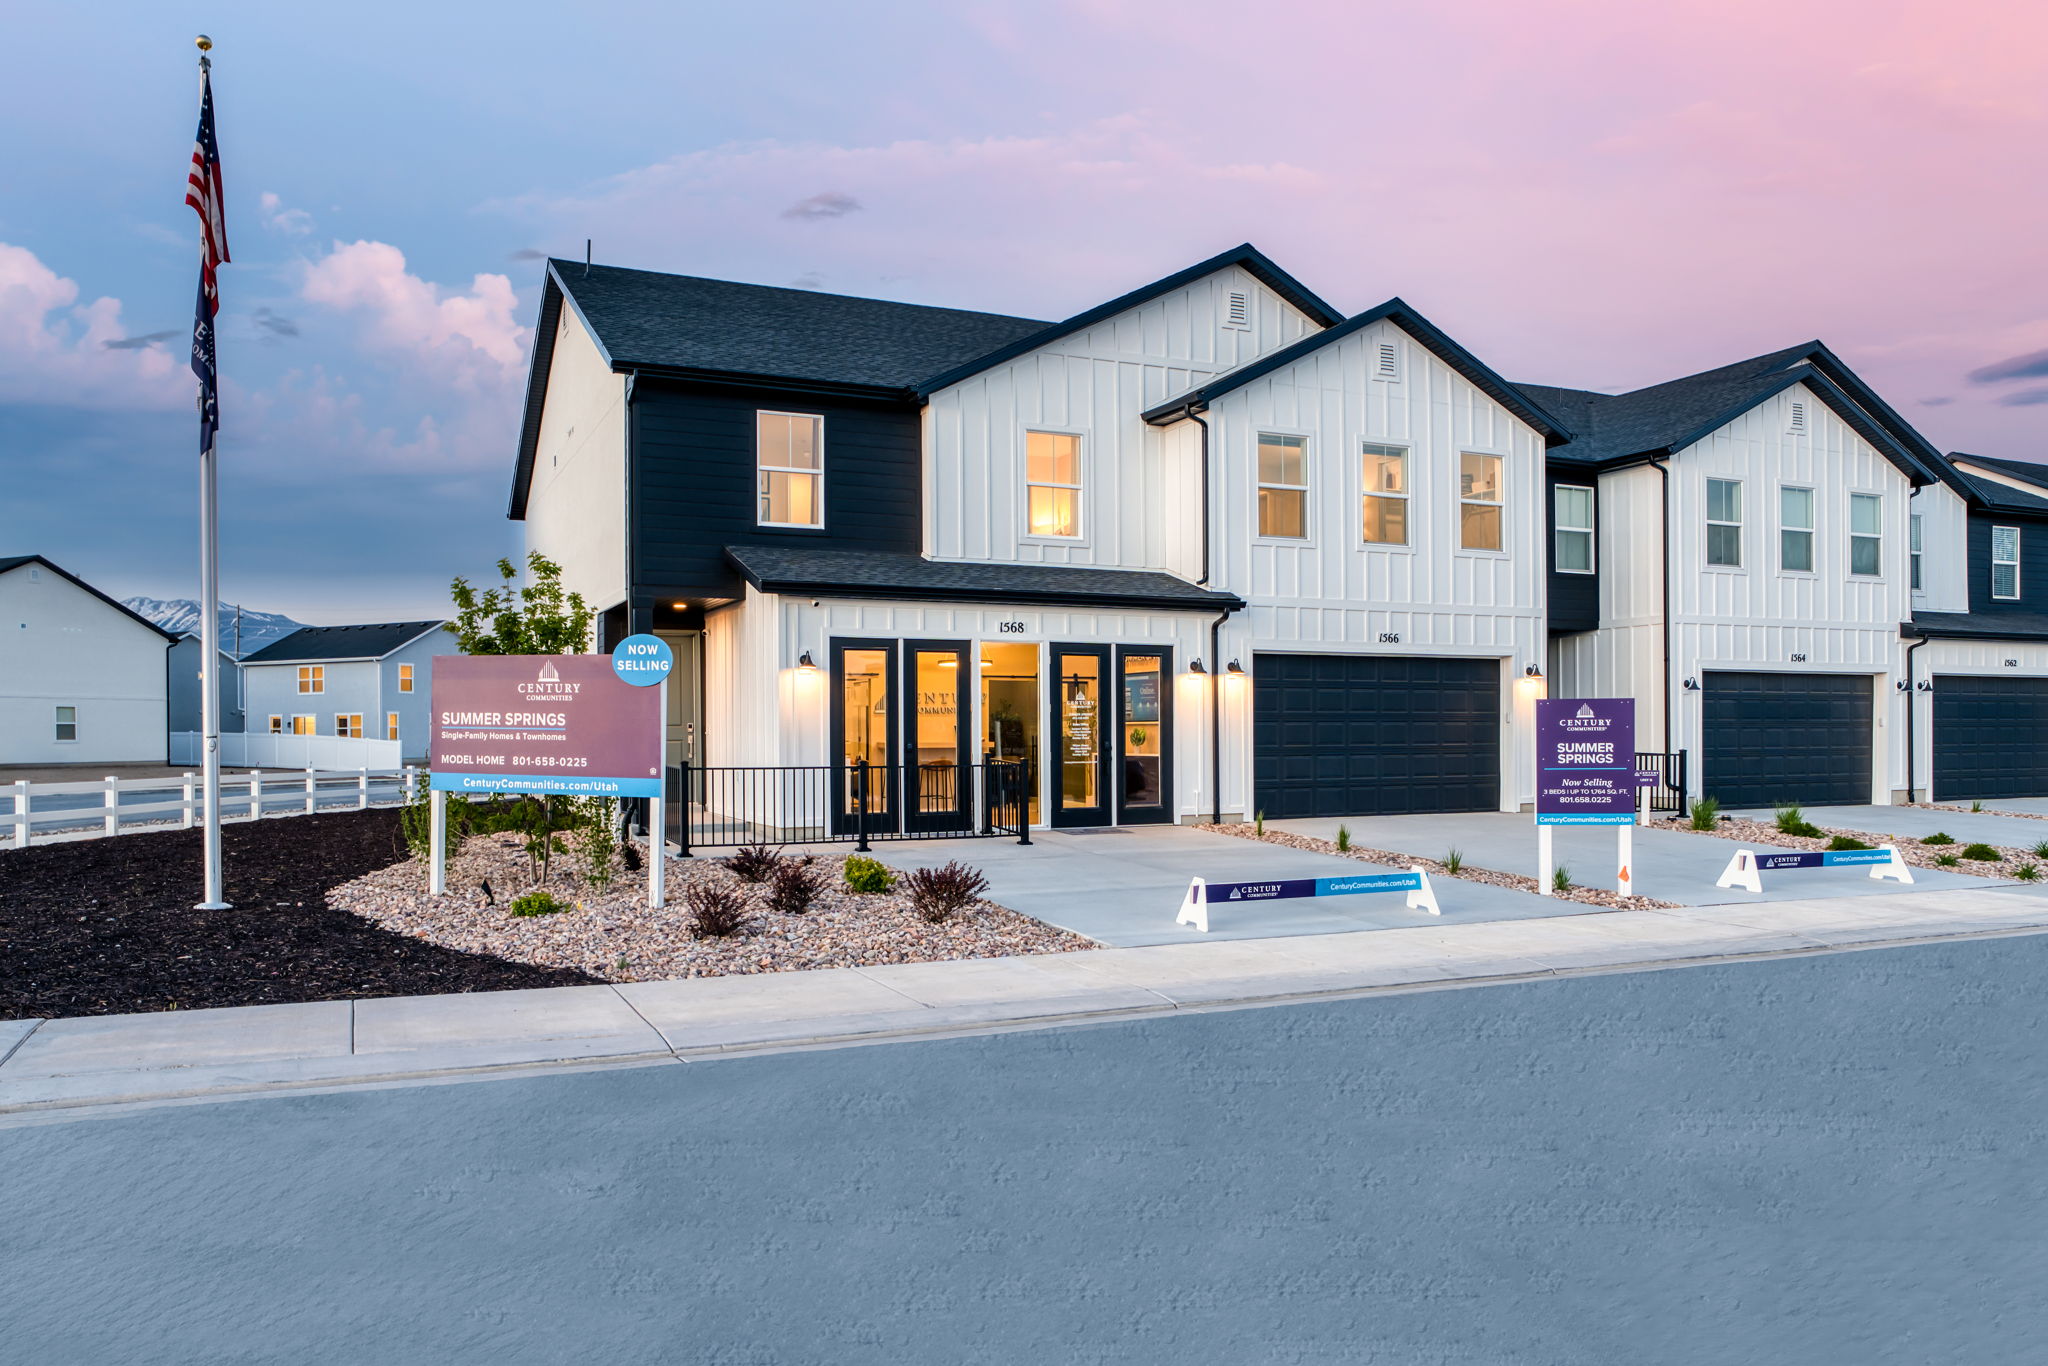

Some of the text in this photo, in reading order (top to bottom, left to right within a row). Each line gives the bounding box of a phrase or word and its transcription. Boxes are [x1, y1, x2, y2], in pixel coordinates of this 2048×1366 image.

[1000, 621, 1025, 634] 1568
[1379, 632, 1400, 644] 1566
[628, 644, 659, 655] NOW
[1790, 653, 1806, 662] 1564
[617, 660, 669, 671] SELLING
[2004, 659, 2017, 667] 1562
[517, 683, 580, 693] CENTURY
[441, 712, 566, 726] SUMMER SPRINGS
[1559, 719, 1612, 727] CENTURY
[441, 731, 488, 741] Single-Family
[489, 732, 514, 740] Homes
[522, 732, 566, 741] Townhomes
[1557, 743, 1614, 753] SUMMER
[441, 754, 587, 767] MODEL HOME 801-658-0225
[1557, 754, 1614, 764] SPRINGS
[463, 778, 619, 791] CenturyCommunities.com/Utah
[1562, 778, 1613, 788] Now Selling
[1539, 816, 1633, 824] CenturyCommunities.com/Utah
[1241, 885, 1282, 893] CENTURY
[1330, 879, 1416, 891] CenturyCommunities.com/Utah
